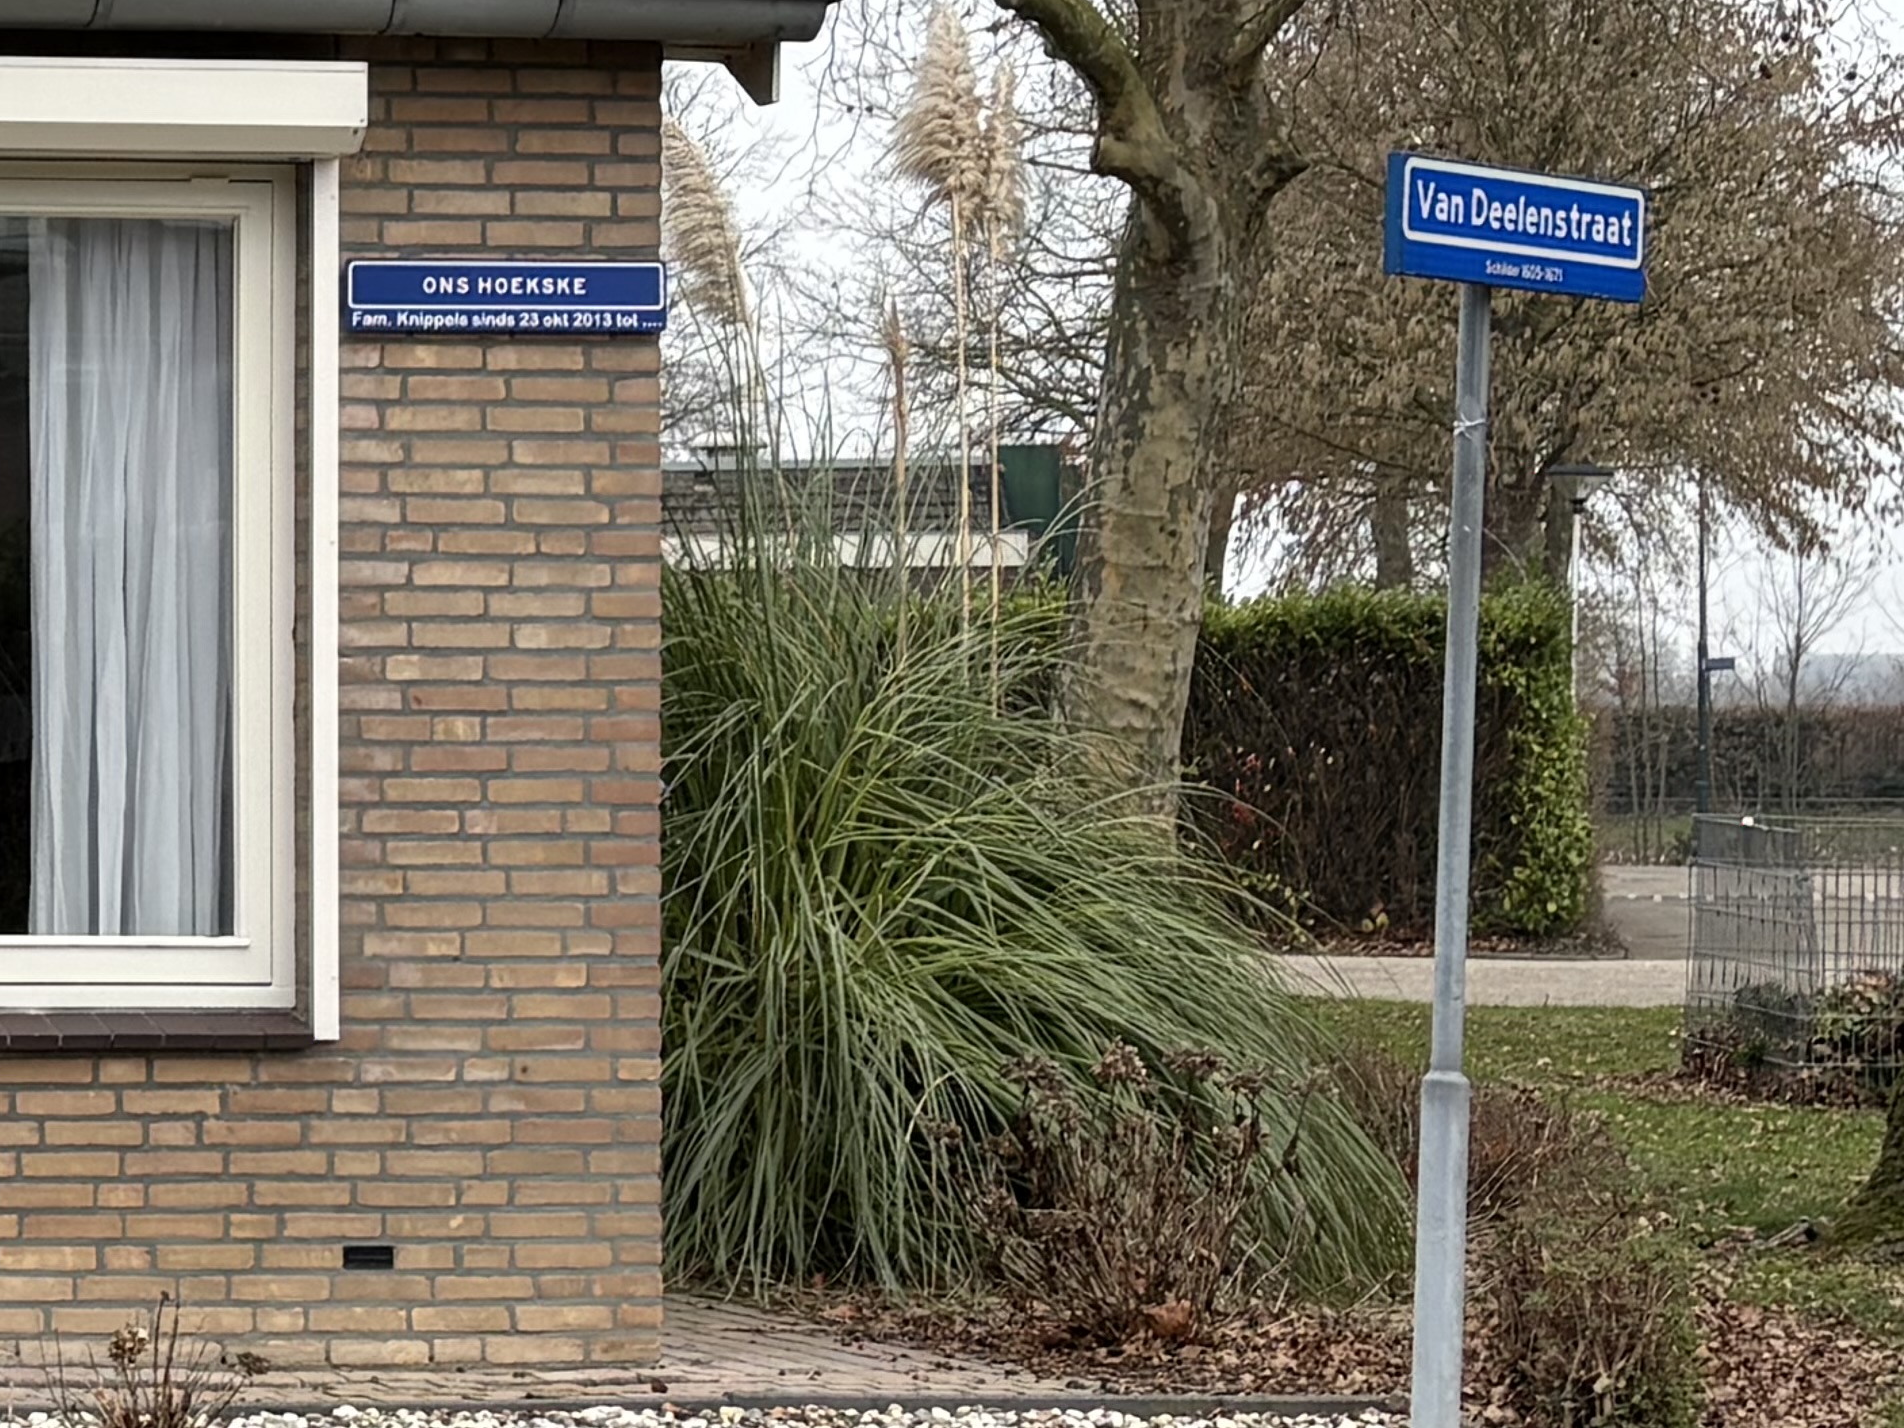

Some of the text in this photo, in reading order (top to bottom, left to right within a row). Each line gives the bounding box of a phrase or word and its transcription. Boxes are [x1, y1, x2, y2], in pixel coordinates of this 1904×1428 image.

[1416, 179, 1632, 247] Van Deelenstraat
[422, 276, 587, 295] ONS HOEKSKE
[352, 311, 392, 327] Fam.
[472, 311, 515, 327] sinds
[519, 312, 539, 328] 23
[543, 312, 569, 328] okt
[573, 312, 612, 328] 2013
[616, 312, 638, 328] tot
